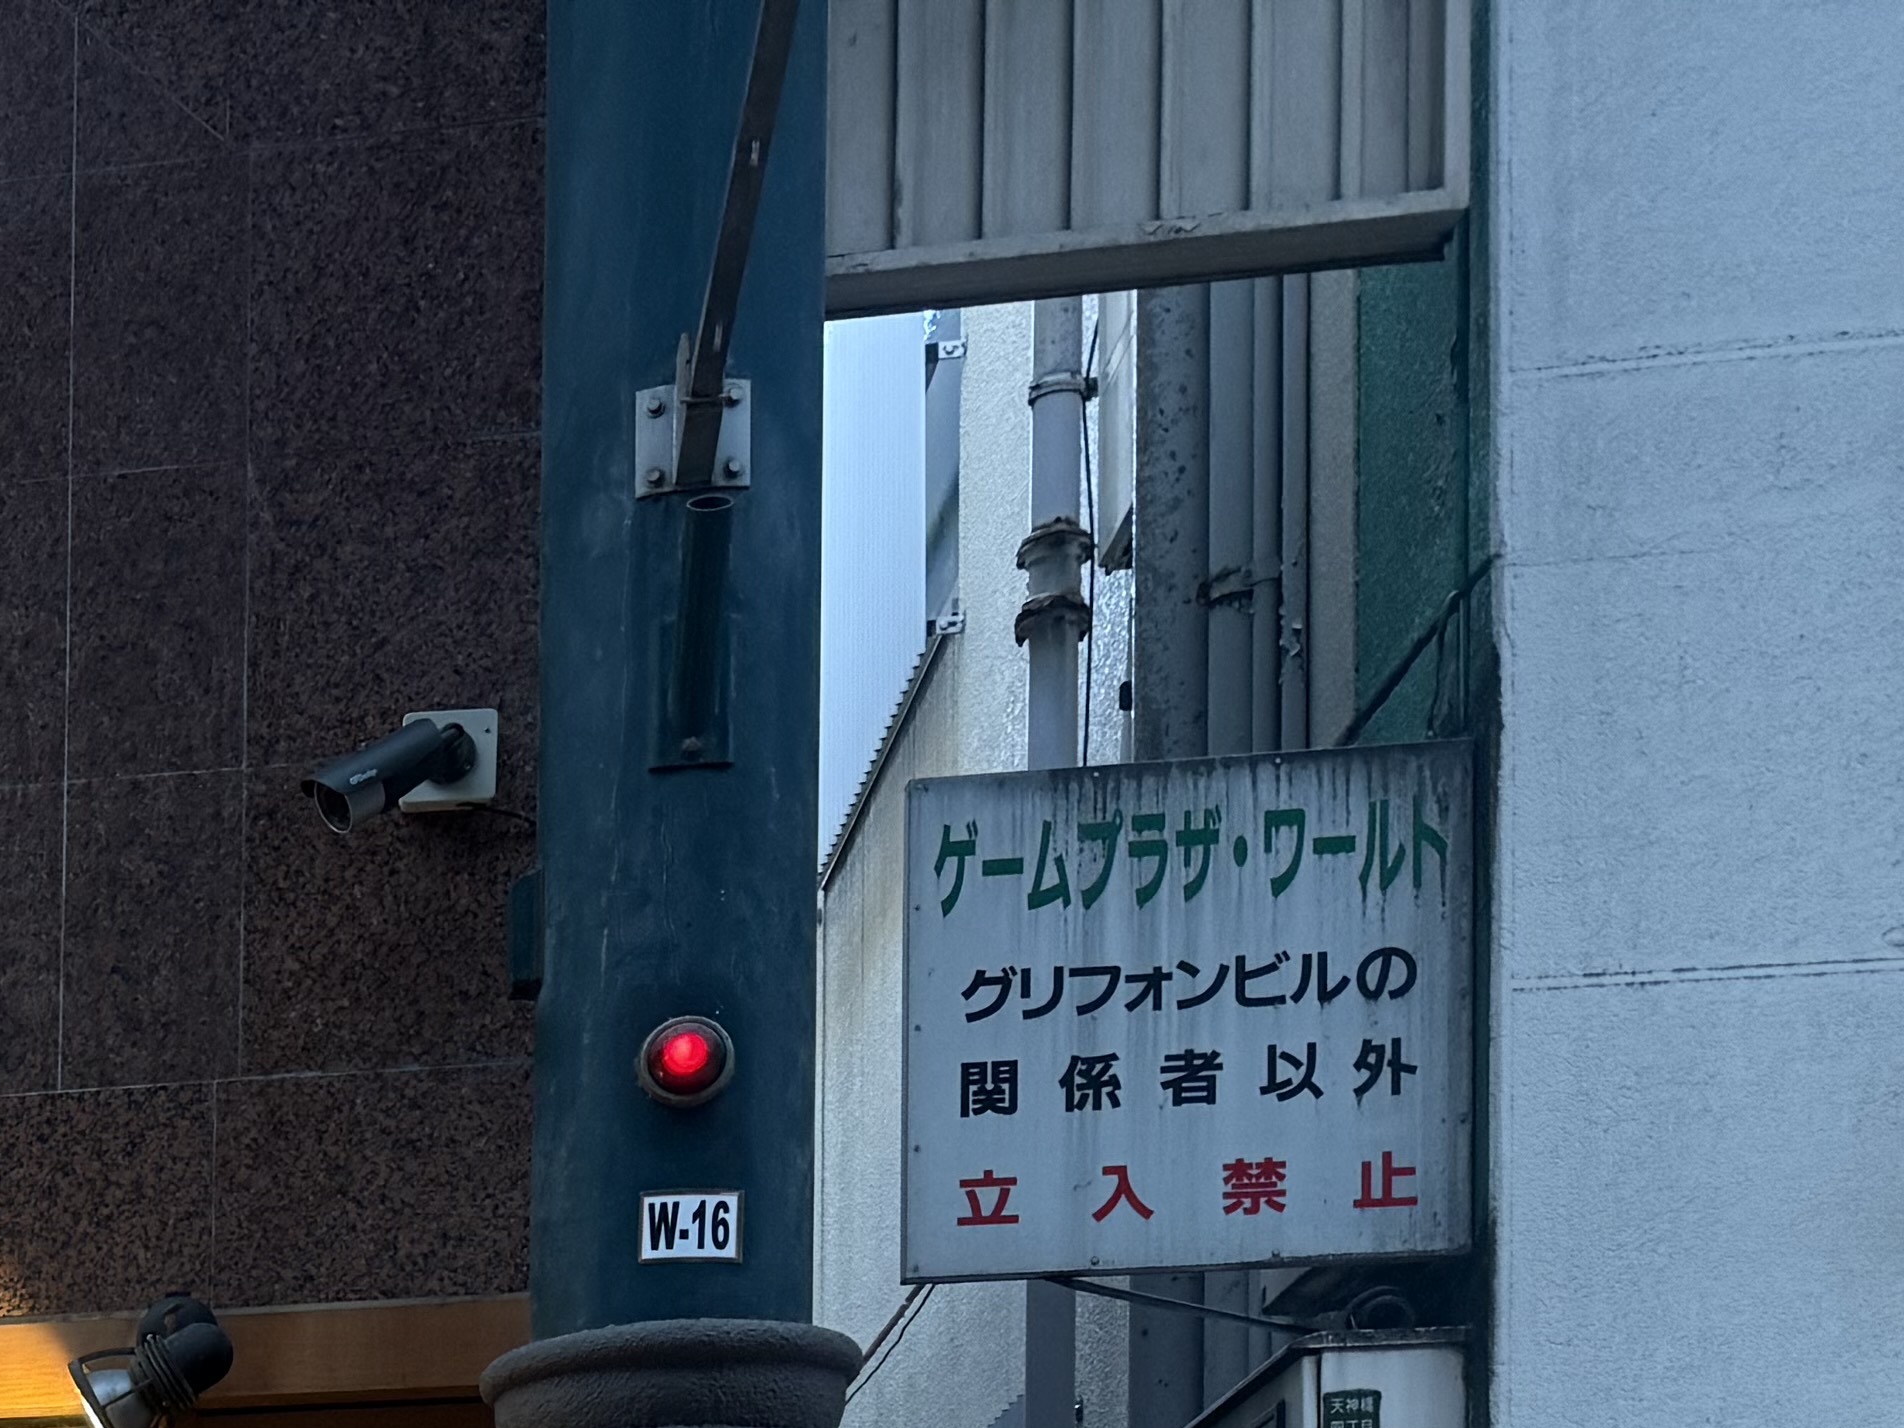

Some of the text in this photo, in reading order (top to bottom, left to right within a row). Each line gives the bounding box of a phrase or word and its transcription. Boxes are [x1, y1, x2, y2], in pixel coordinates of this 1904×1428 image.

[960, 945, 1418, 1024] グリフォンビルの
[959, 1037, 1418, 1118] 関係者以外
[648, 1199, 730, 1252] W-16
[957, 1150, 1418, 1226] 立入禁止
